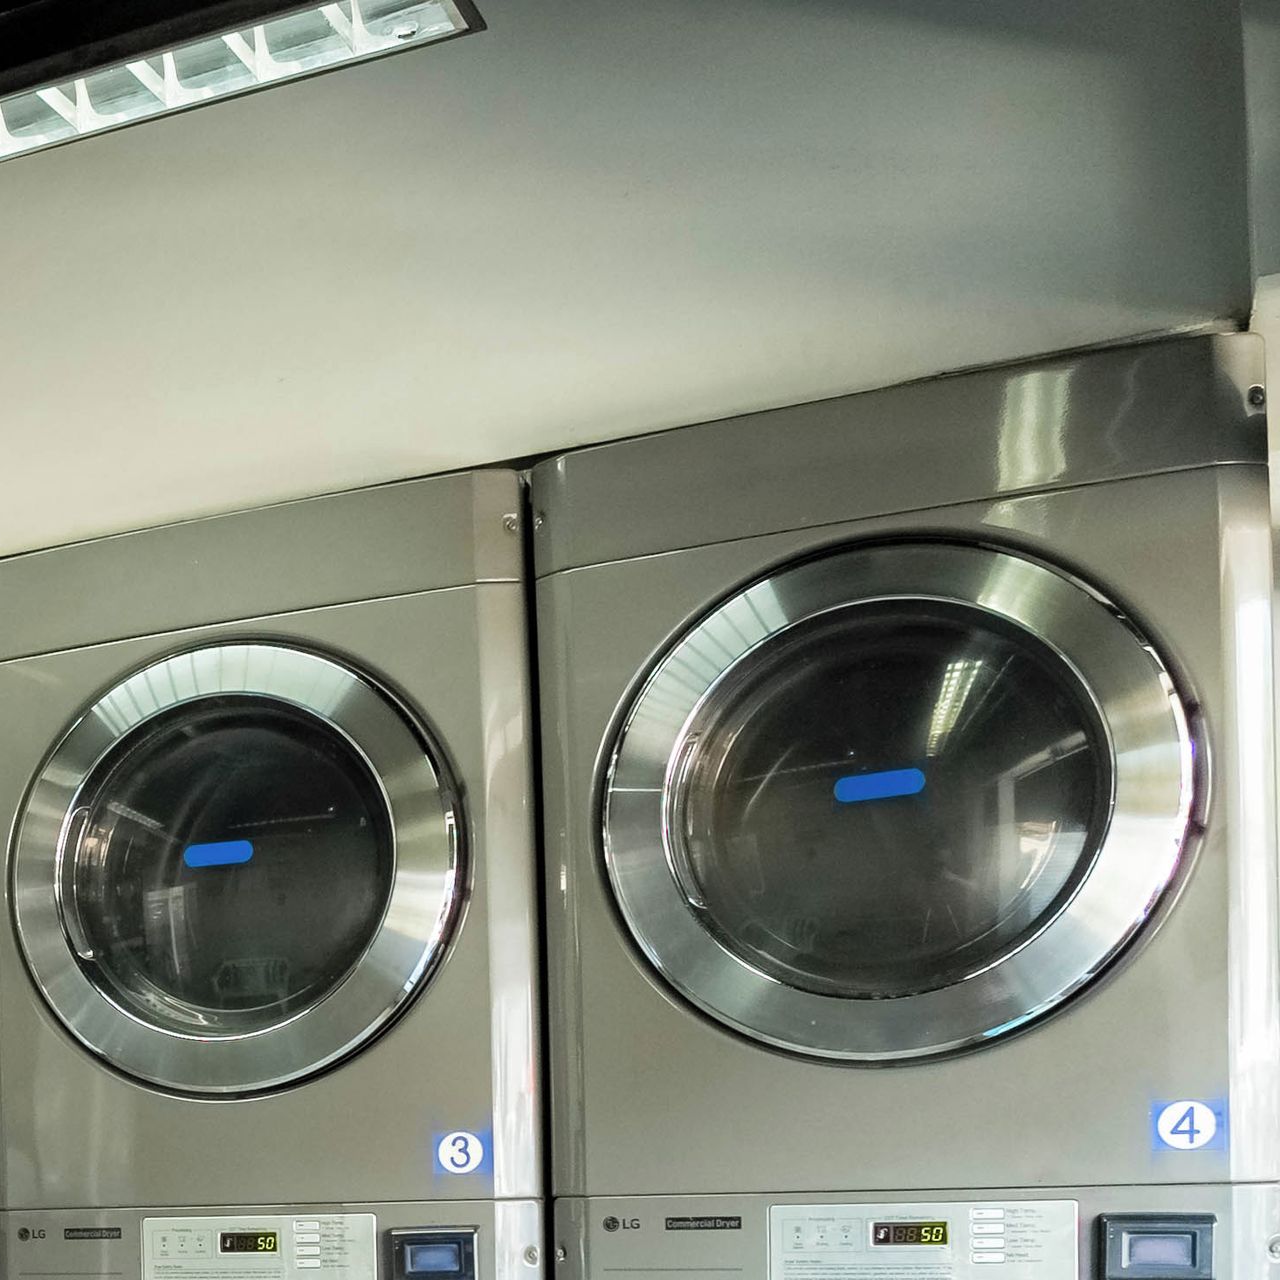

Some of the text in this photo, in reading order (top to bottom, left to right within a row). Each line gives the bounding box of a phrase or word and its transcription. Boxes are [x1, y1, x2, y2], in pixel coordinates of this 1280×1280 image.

[1170, 1106, 1201, 1144] 4
[450, 1136, 471, 1168] 3
[622, 1218, 640, 1229] LG
[667, 1218, 740, 1228] Commercial Dryer
[32, 1229, 46, 1239] LG
[920, 1227, 943, 1242] 50
[256, 1237, 275, 1250] 50
